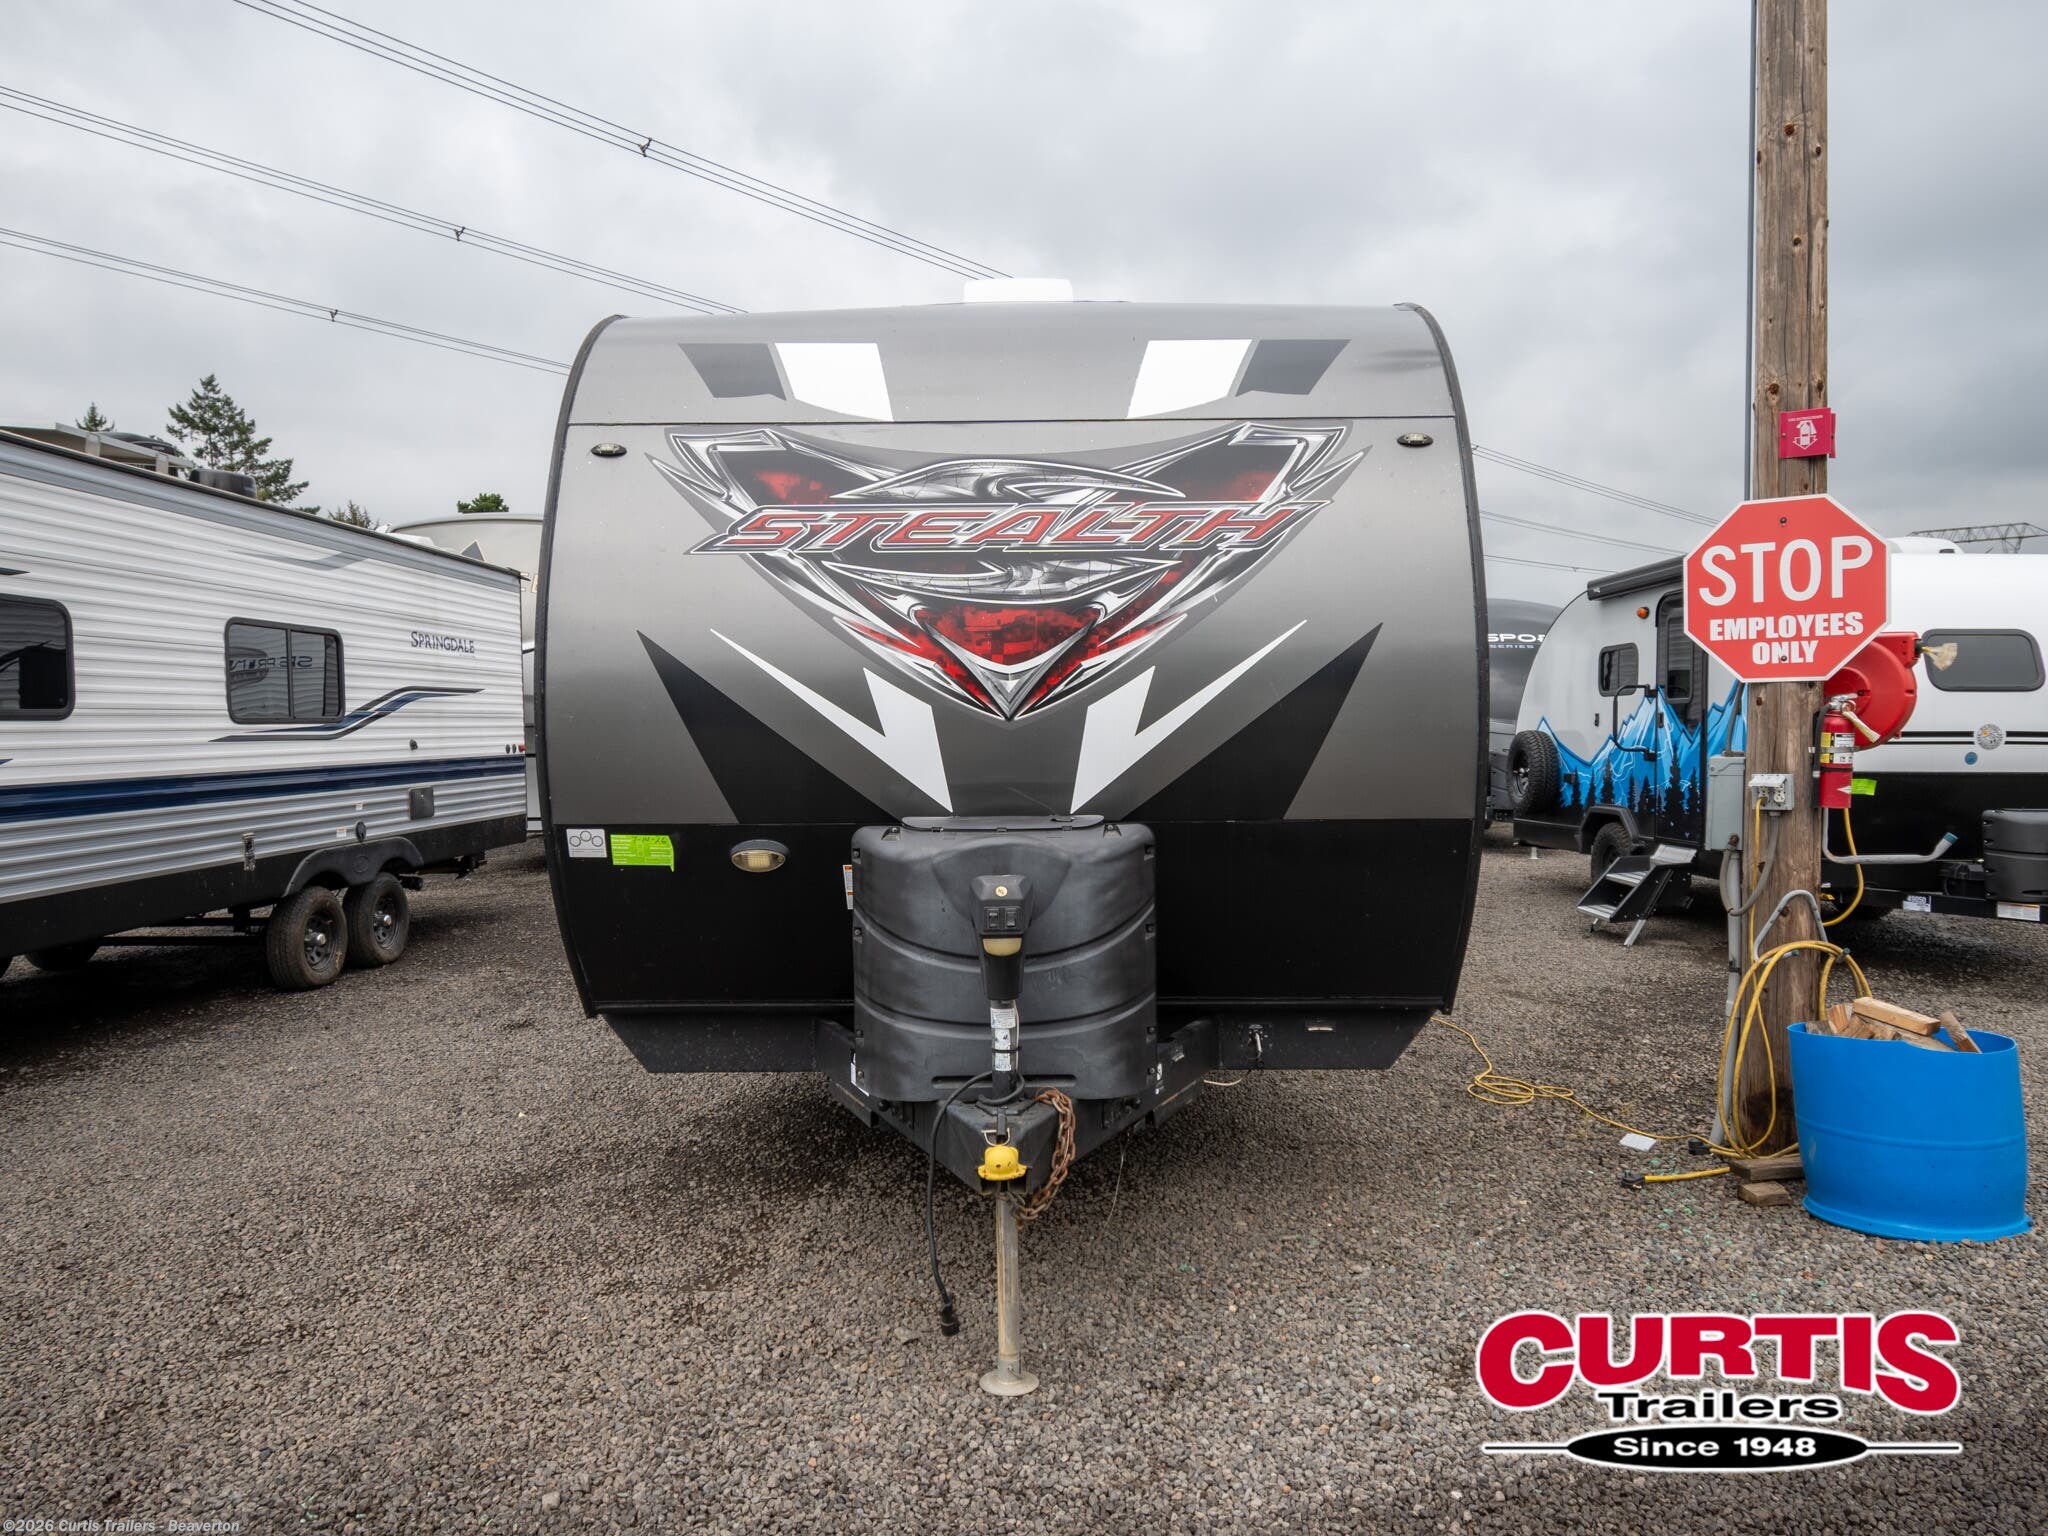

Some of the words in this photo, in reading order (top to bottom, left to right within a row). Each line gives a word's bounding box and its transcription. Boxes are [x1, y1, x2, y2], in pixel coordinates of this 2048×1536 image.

[712, 504, 1306, 549] STEALTH
[1699, 535, 1873, 606] STOP
[1710, 612, 1864, 641] EMPLOYEES
[411, 631, 475, 653] SPRINGDALE
[1752, 640, 1819, 665] ONLY
